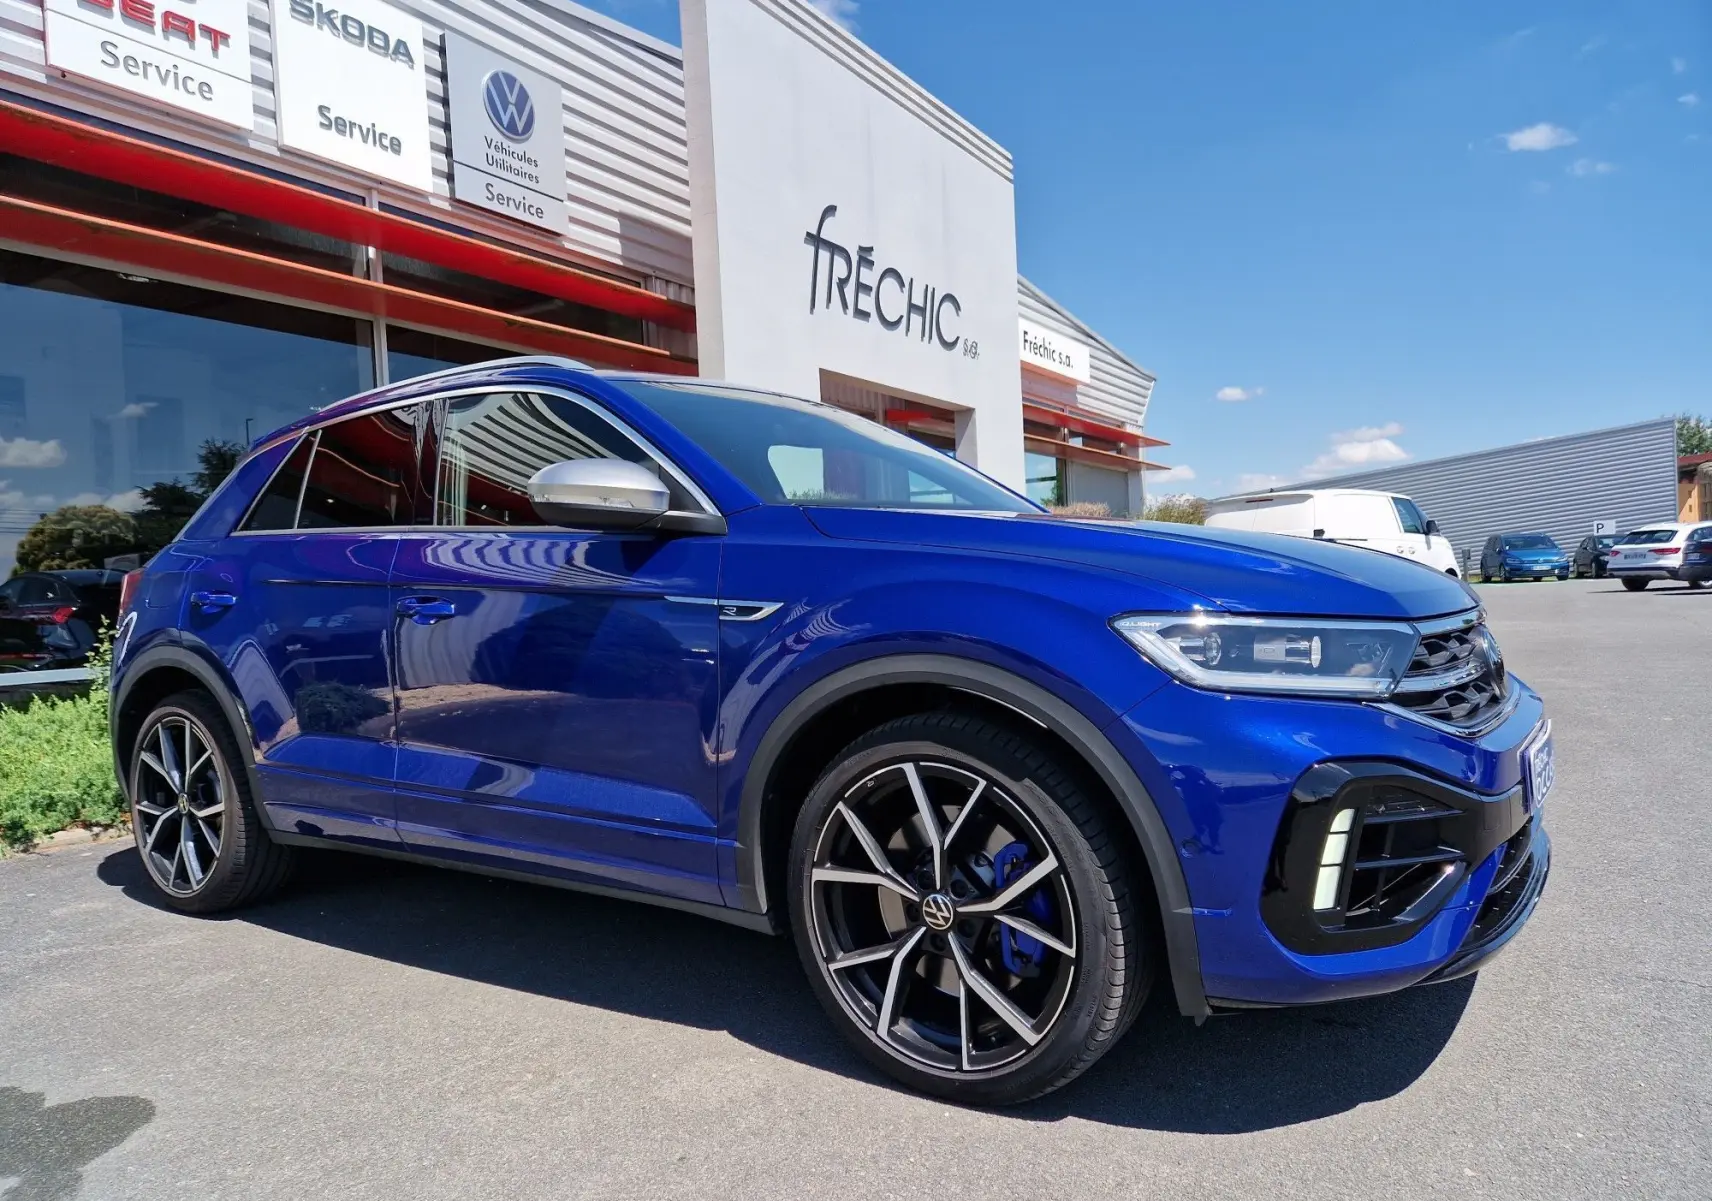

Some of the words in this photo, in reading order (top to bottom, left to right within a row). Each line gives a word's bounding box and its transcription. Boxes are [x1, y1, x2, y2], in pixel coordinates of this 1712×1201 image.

[100, 40, 213, 101] Service
[317, 104, 402, 156] Service
[484, 135, 539, 168] Véhicules
[485, 152, 540, 184] Utilitaires
[485, 182, 544, 219] Service
[1023, 330, 1056, 362] Fréchic
[1058, 351, 1074, 369] s.a.
[1596, 522, 1605, 534] P
[722, 606, 737, 616] R
